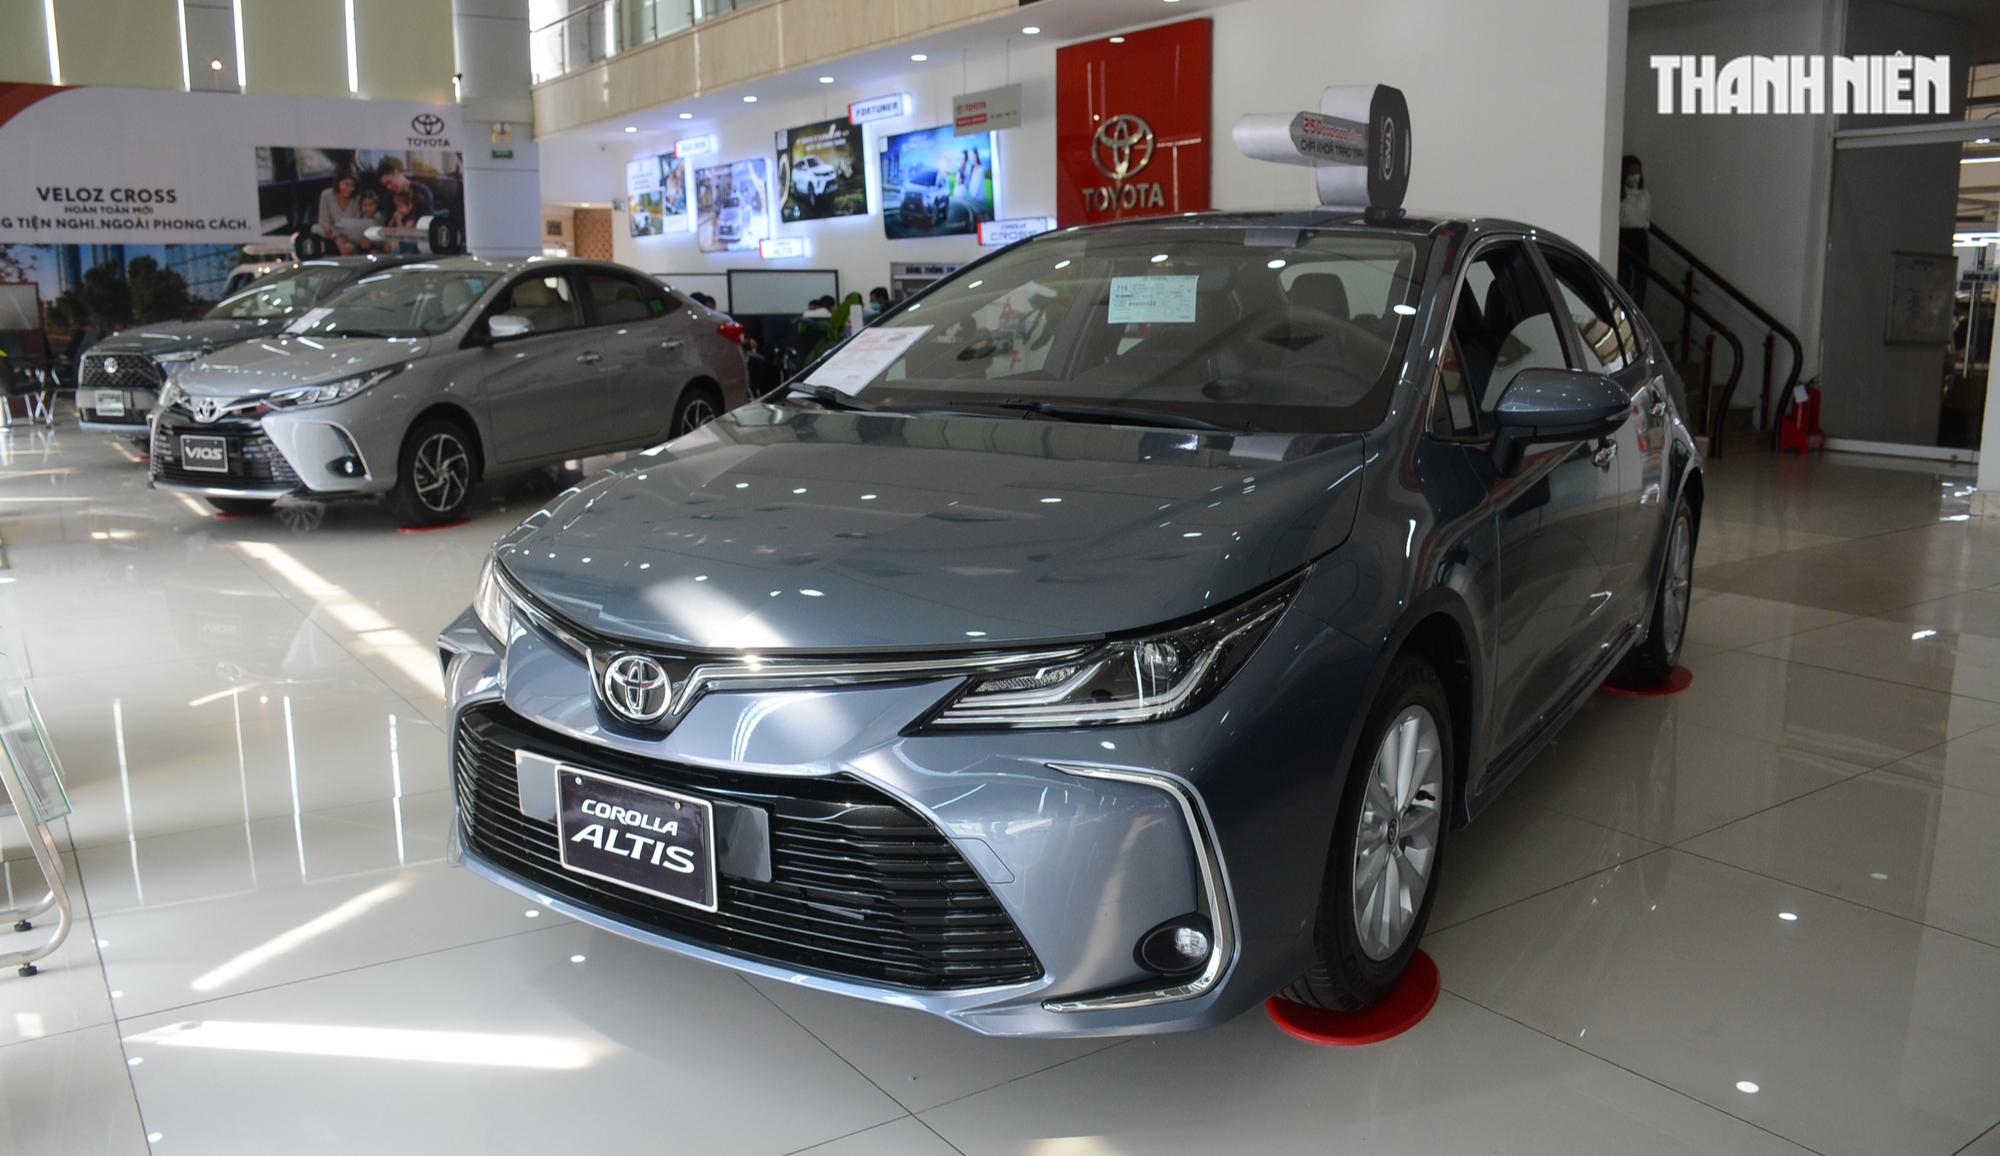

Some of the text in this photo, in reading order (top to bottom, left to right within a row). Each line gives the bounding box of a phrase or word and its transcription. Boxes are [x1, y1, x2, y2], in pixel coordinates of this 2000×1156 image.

[407, 137, 451, 148] TOYOTA
[37, 186, 178, 204] VELOZ CROSS
[1082, 182, 1166, 213] TOYOTA
[64, 204, 97, 214] HOÀN
[101, 205, 130, 214] TOÀN
[17, 217, 51, 231] TIỆN
[153, 218, 205, 230] PHONG
[184, 445, 223, 461] VIOS
[581, 799, 679, 837] COROLLA
[570, 824, 695, 874] ALTIS
